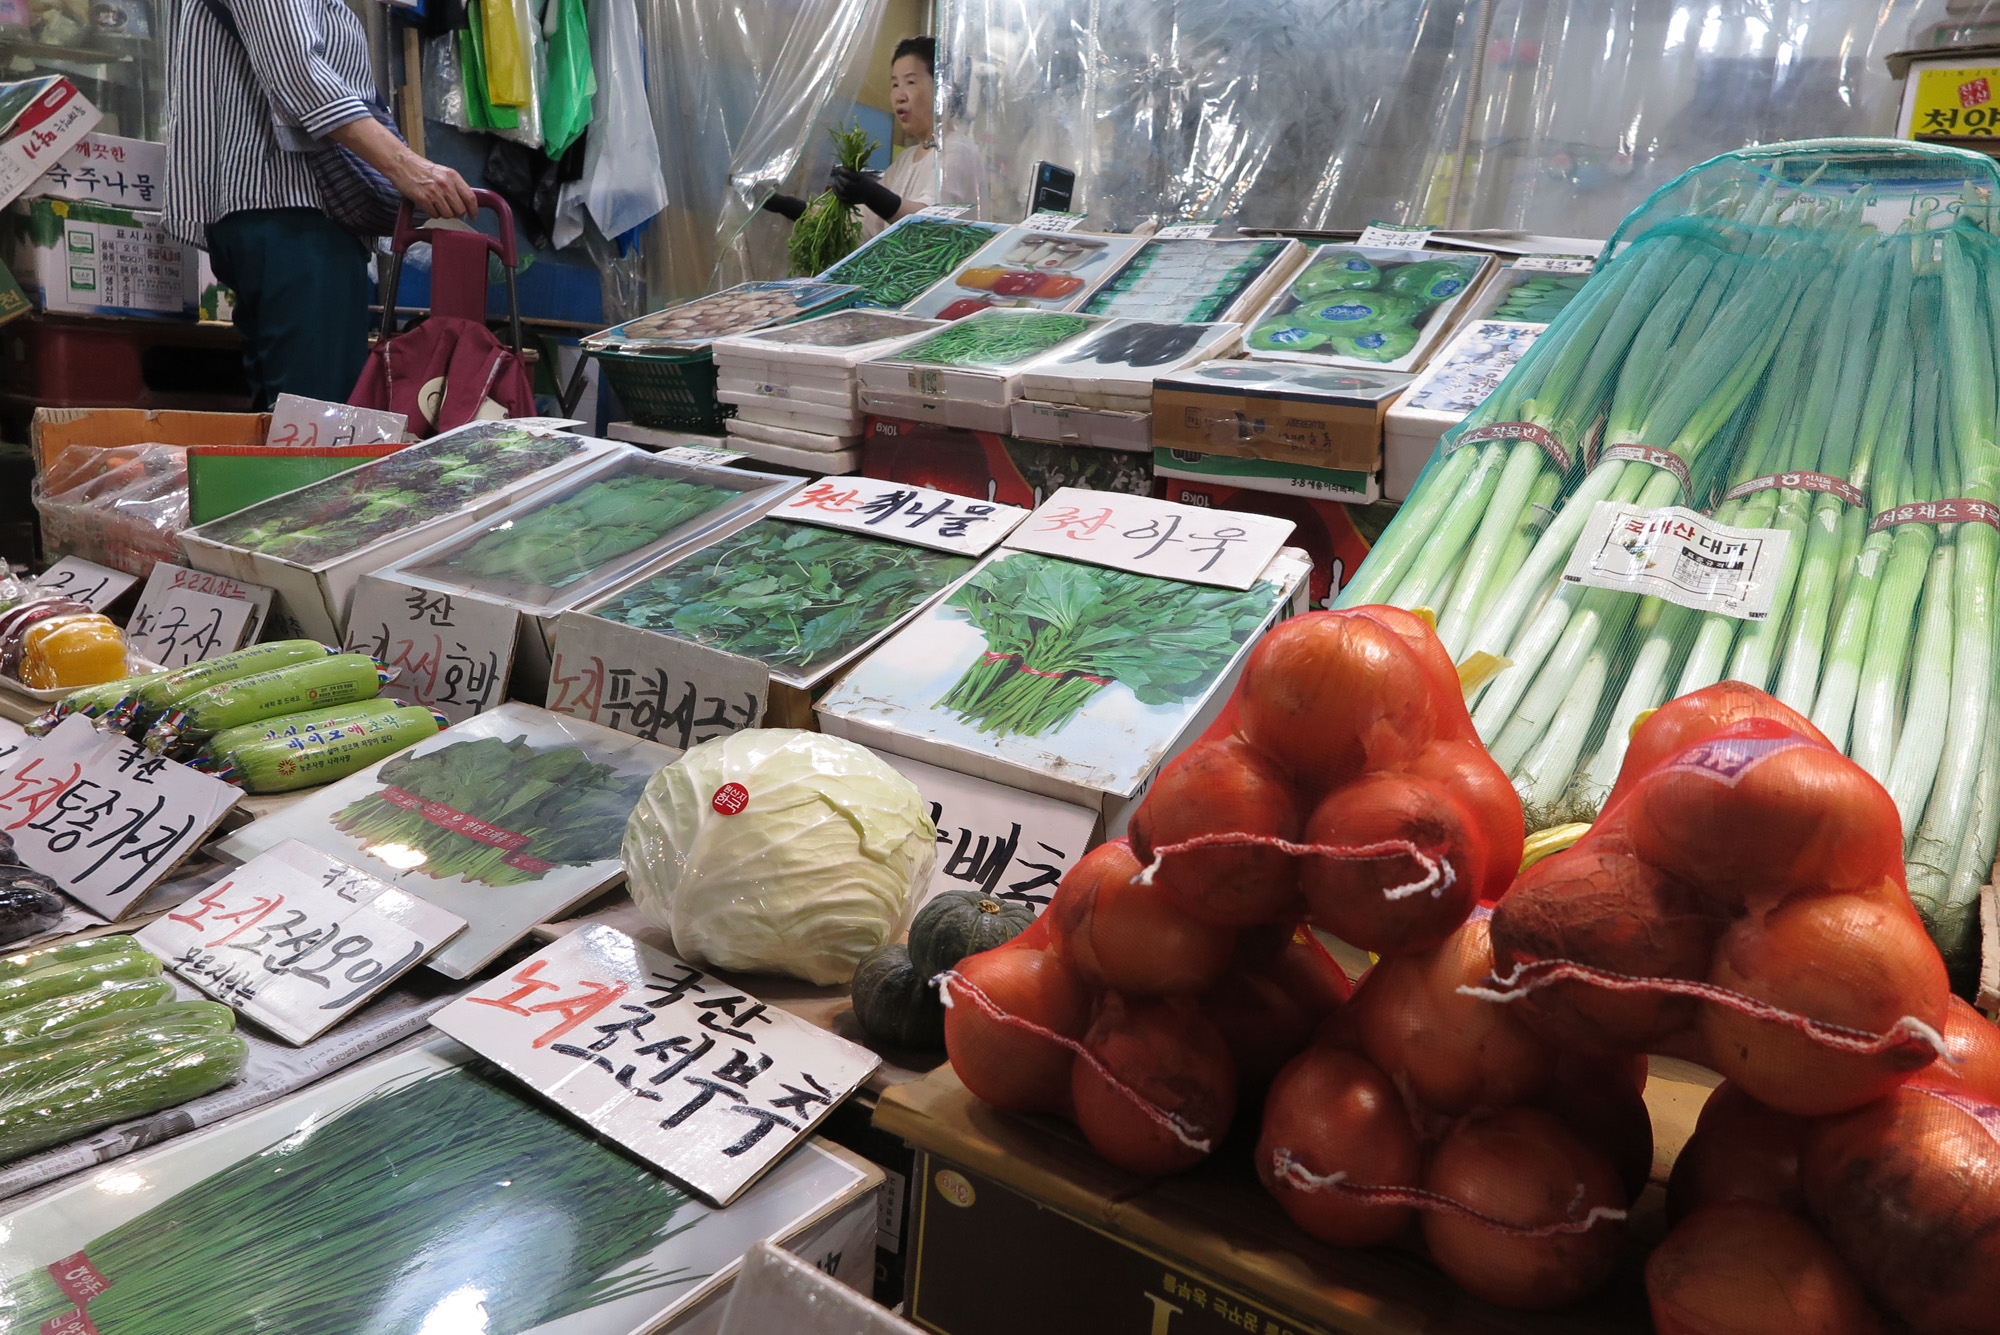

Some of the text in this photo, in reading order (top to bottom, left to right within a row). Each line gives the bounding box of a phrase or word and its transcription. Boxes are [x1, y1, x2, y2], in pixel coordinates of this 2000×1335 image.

[46, 161, 155, 202] 숙주나물
[876, 422, 898, 437] 10kg
[1491, 425, 1539, 440] 작목반
[788, 483, 864, 514] 국산
[855, 489, 997, 538] 취나물
[1181, 489, 1211, 506] 10kg
[1033, 505, 1250, 573] 국산 아욱
[1625, 518, 1749, 557] 국내산 대파
[405, 586, 457, 628] 국산
[157, 606, 223, 668] 국산
[549, 653, 605, 724] 노지
[117, 743, 168, 785] 국산
[299, 754, 351, 772] 농촌사랑 나라사랑
[327, 746, 339, 756] 살아
[342, 742, 360, 753] 있으며
[361, 737, 379, 749] 저장이
[714, 792, 742, 814] 한국
[723, 784, 748, 802] 원산지
[0, 757, 196, 897] 노지 토종가지
[322, 866, 375, 904] 국산
[167, 880, 286, 949] 노지
[466, 959, 629, 1049] 노지
[644, 963, 773, 1044] 국산
[1212, 1296, 1259, 1334] 꿈꾸는
